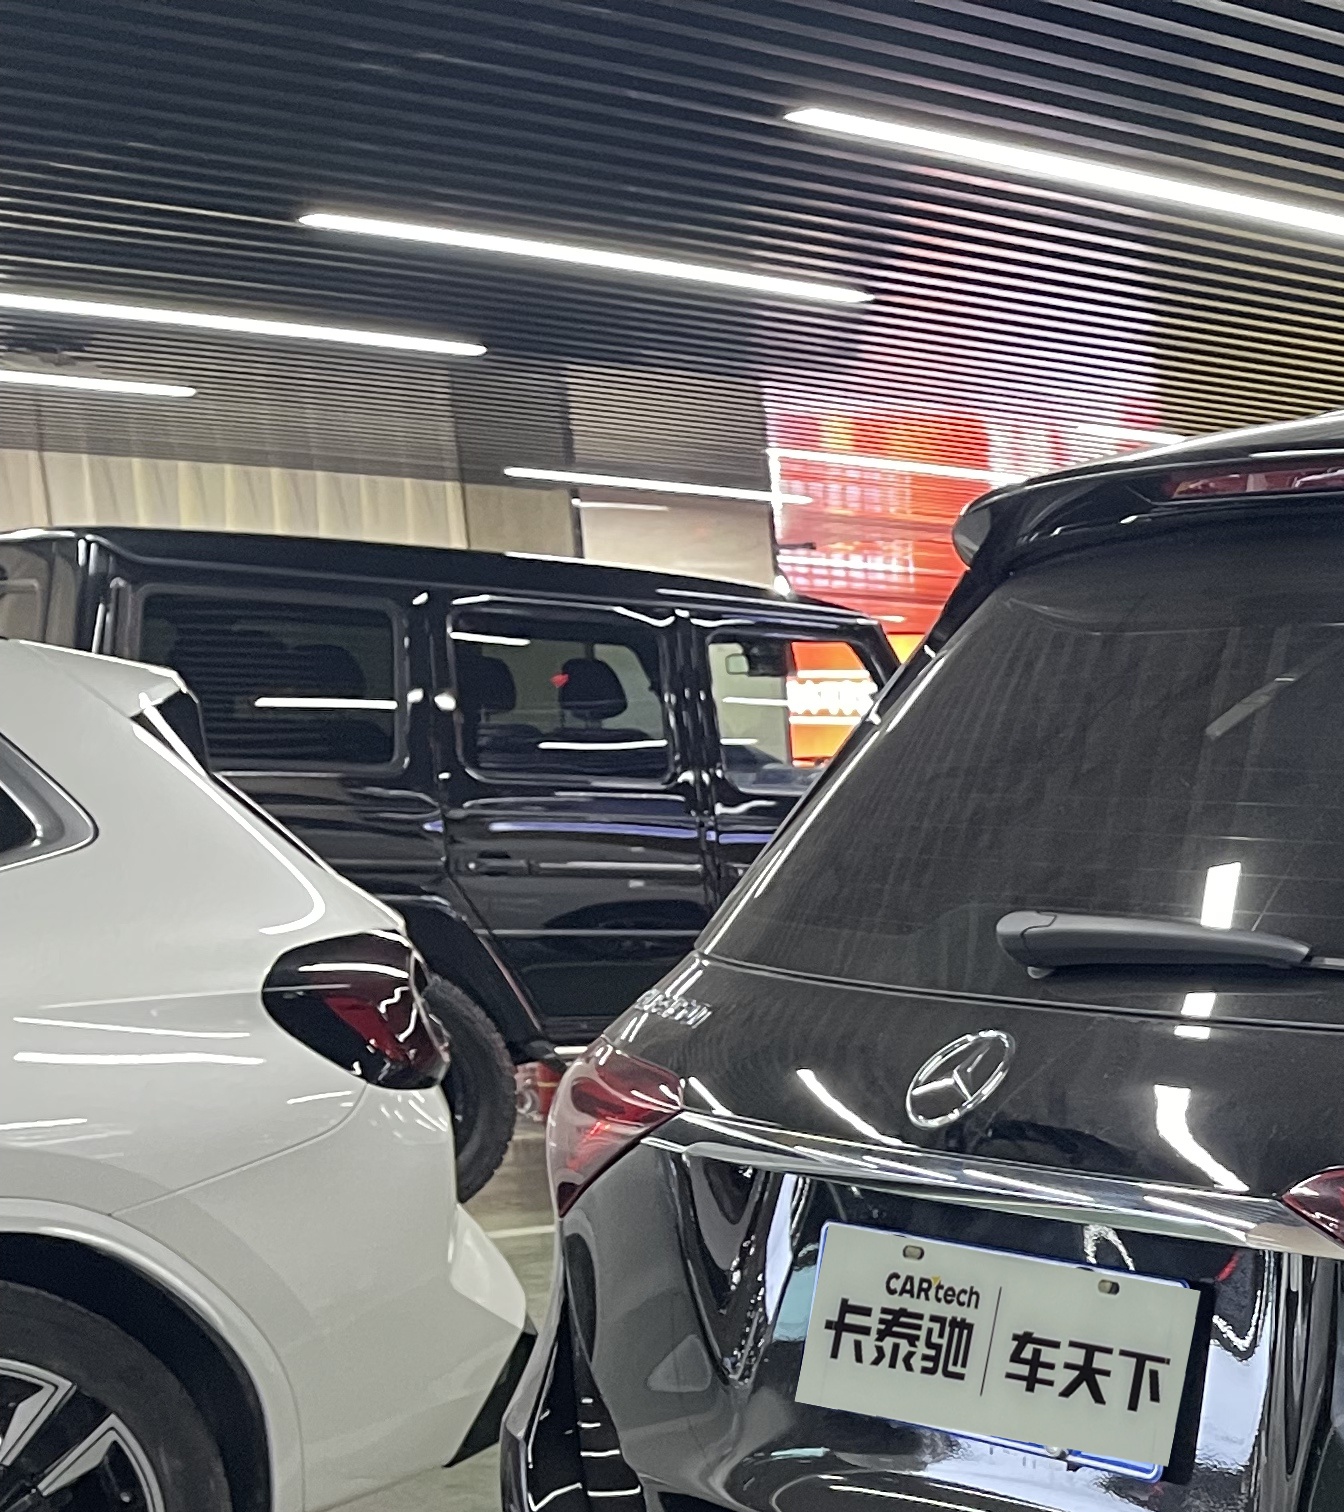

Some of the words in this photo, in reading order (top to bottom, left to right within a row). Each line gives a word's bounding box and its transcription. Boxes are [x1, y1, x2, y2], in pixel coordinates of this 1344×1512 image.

[885, 1272, 980, 1309] CARtech
[824, 1297, 975, 1381] 卡泰驰
[1005, 1331, 1171, 1411] 车天下
